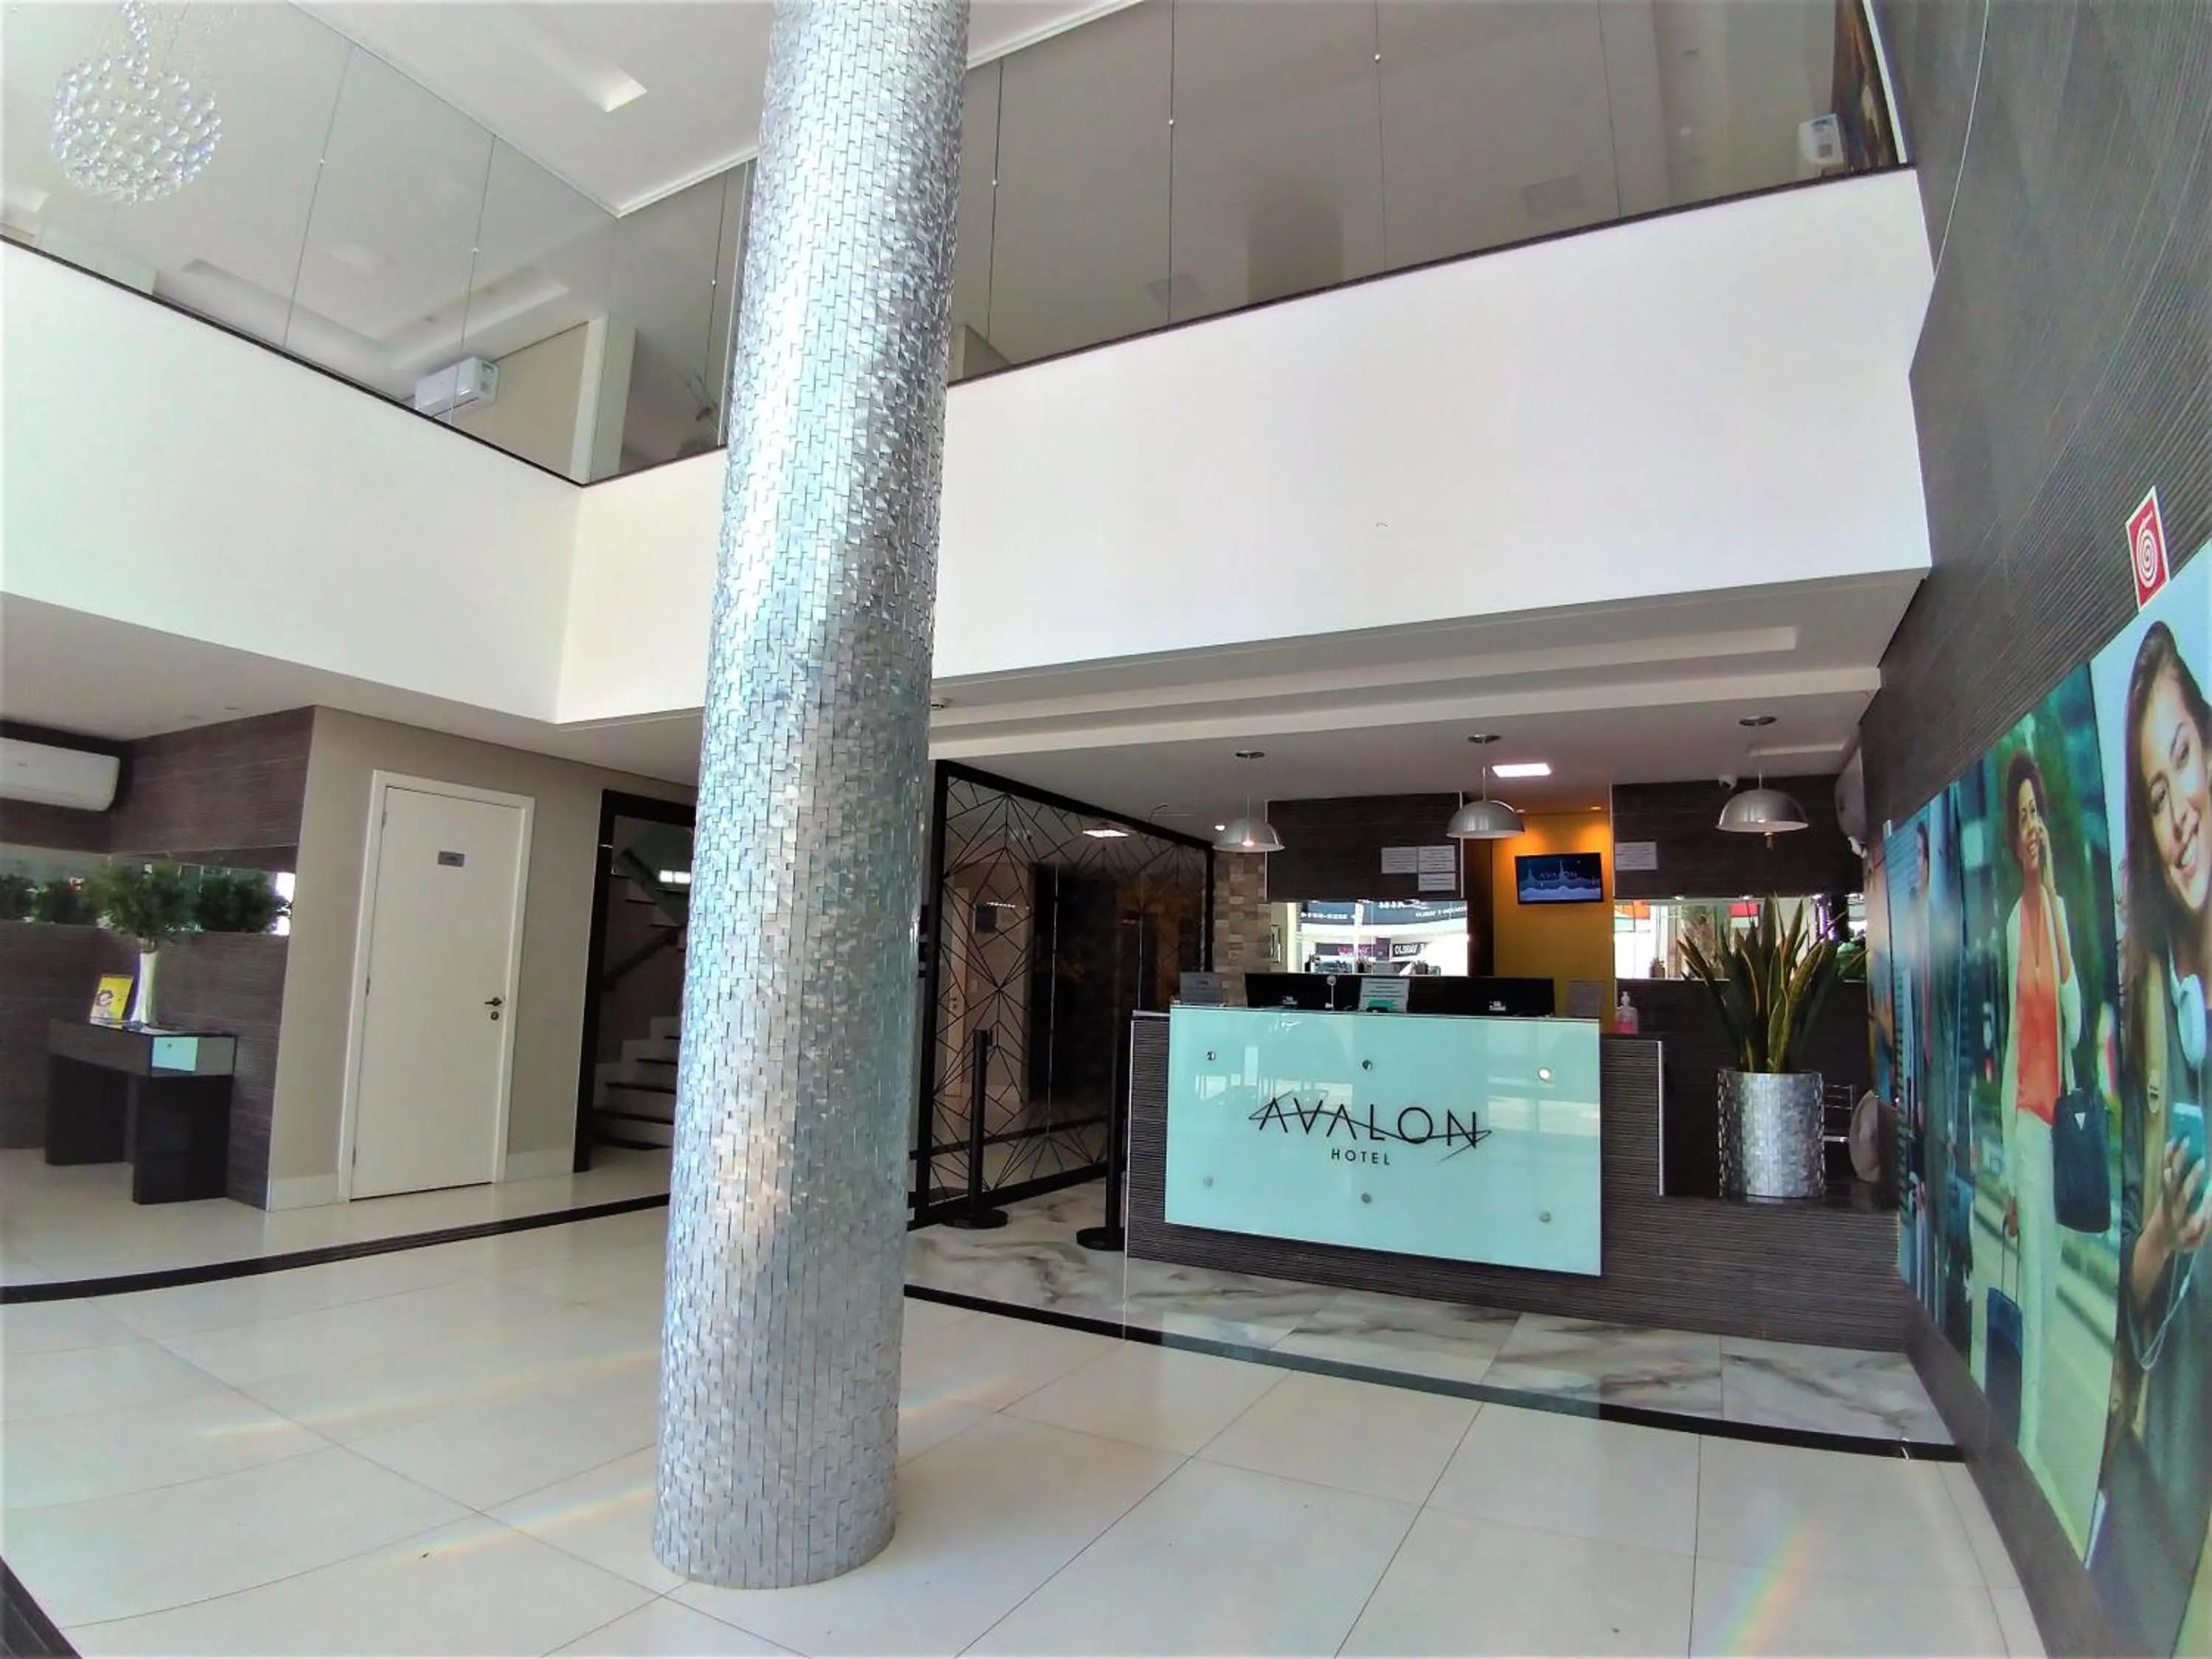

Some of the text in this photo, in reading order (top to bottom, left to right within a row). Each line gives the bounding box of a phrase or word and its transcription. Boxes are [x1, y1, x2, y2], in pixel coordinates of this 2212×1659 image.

[1539, 870, 1578, 880] AVAON
[1259, 1096, 1477, 1149] AVALON
[1331, 1148, 1391, 1165] HOTEL
